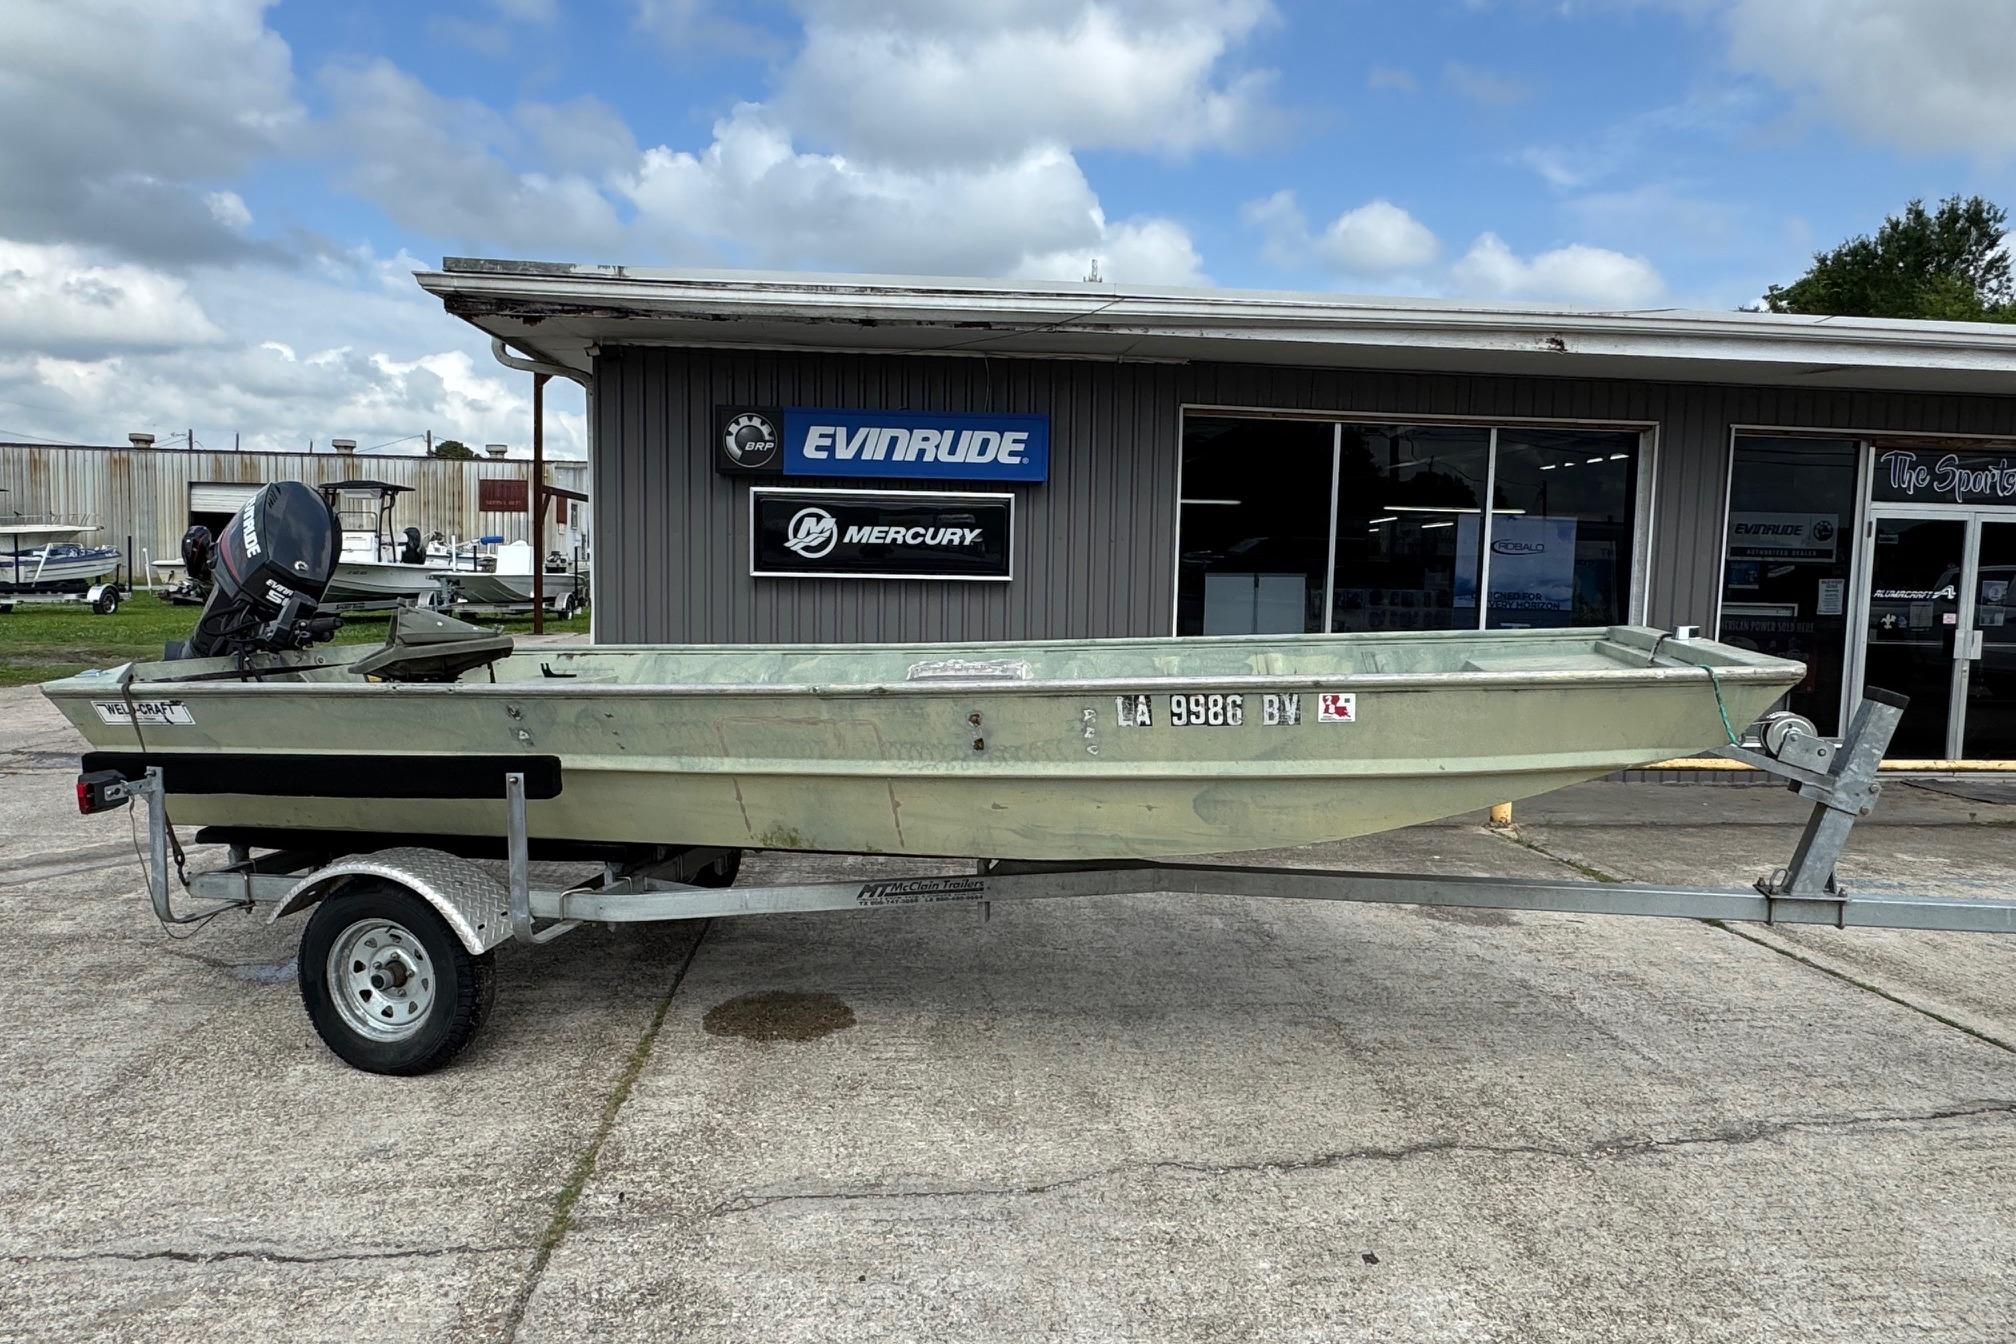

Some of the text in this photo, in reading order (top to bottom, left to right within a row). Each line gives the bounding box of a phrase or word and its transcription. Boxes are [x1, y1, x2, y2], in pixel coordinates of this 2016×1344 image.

[744, 426, 1028, 464] BRP EVINRUDE
[1880, 449, 1930, 495] The
[843, 525, 983, 546] MERCURY
[1733, 522, 1804, 537] EVINRUDE
[1497, 542, 1545, 552] ROBALO
[1522, 592, 1543, 602] FOR
[1873, 589, 1934, 600] ALUMACRAFT
[1516, 601, 1560, 611] HORIZON
[104, 702, 176, 715] WEL-CRAFT
[1115, 694, 1299, 726] LA 9986 BV
[890, 880, 940, 893] McClain
[942, 878, 985, 890] Trailers
